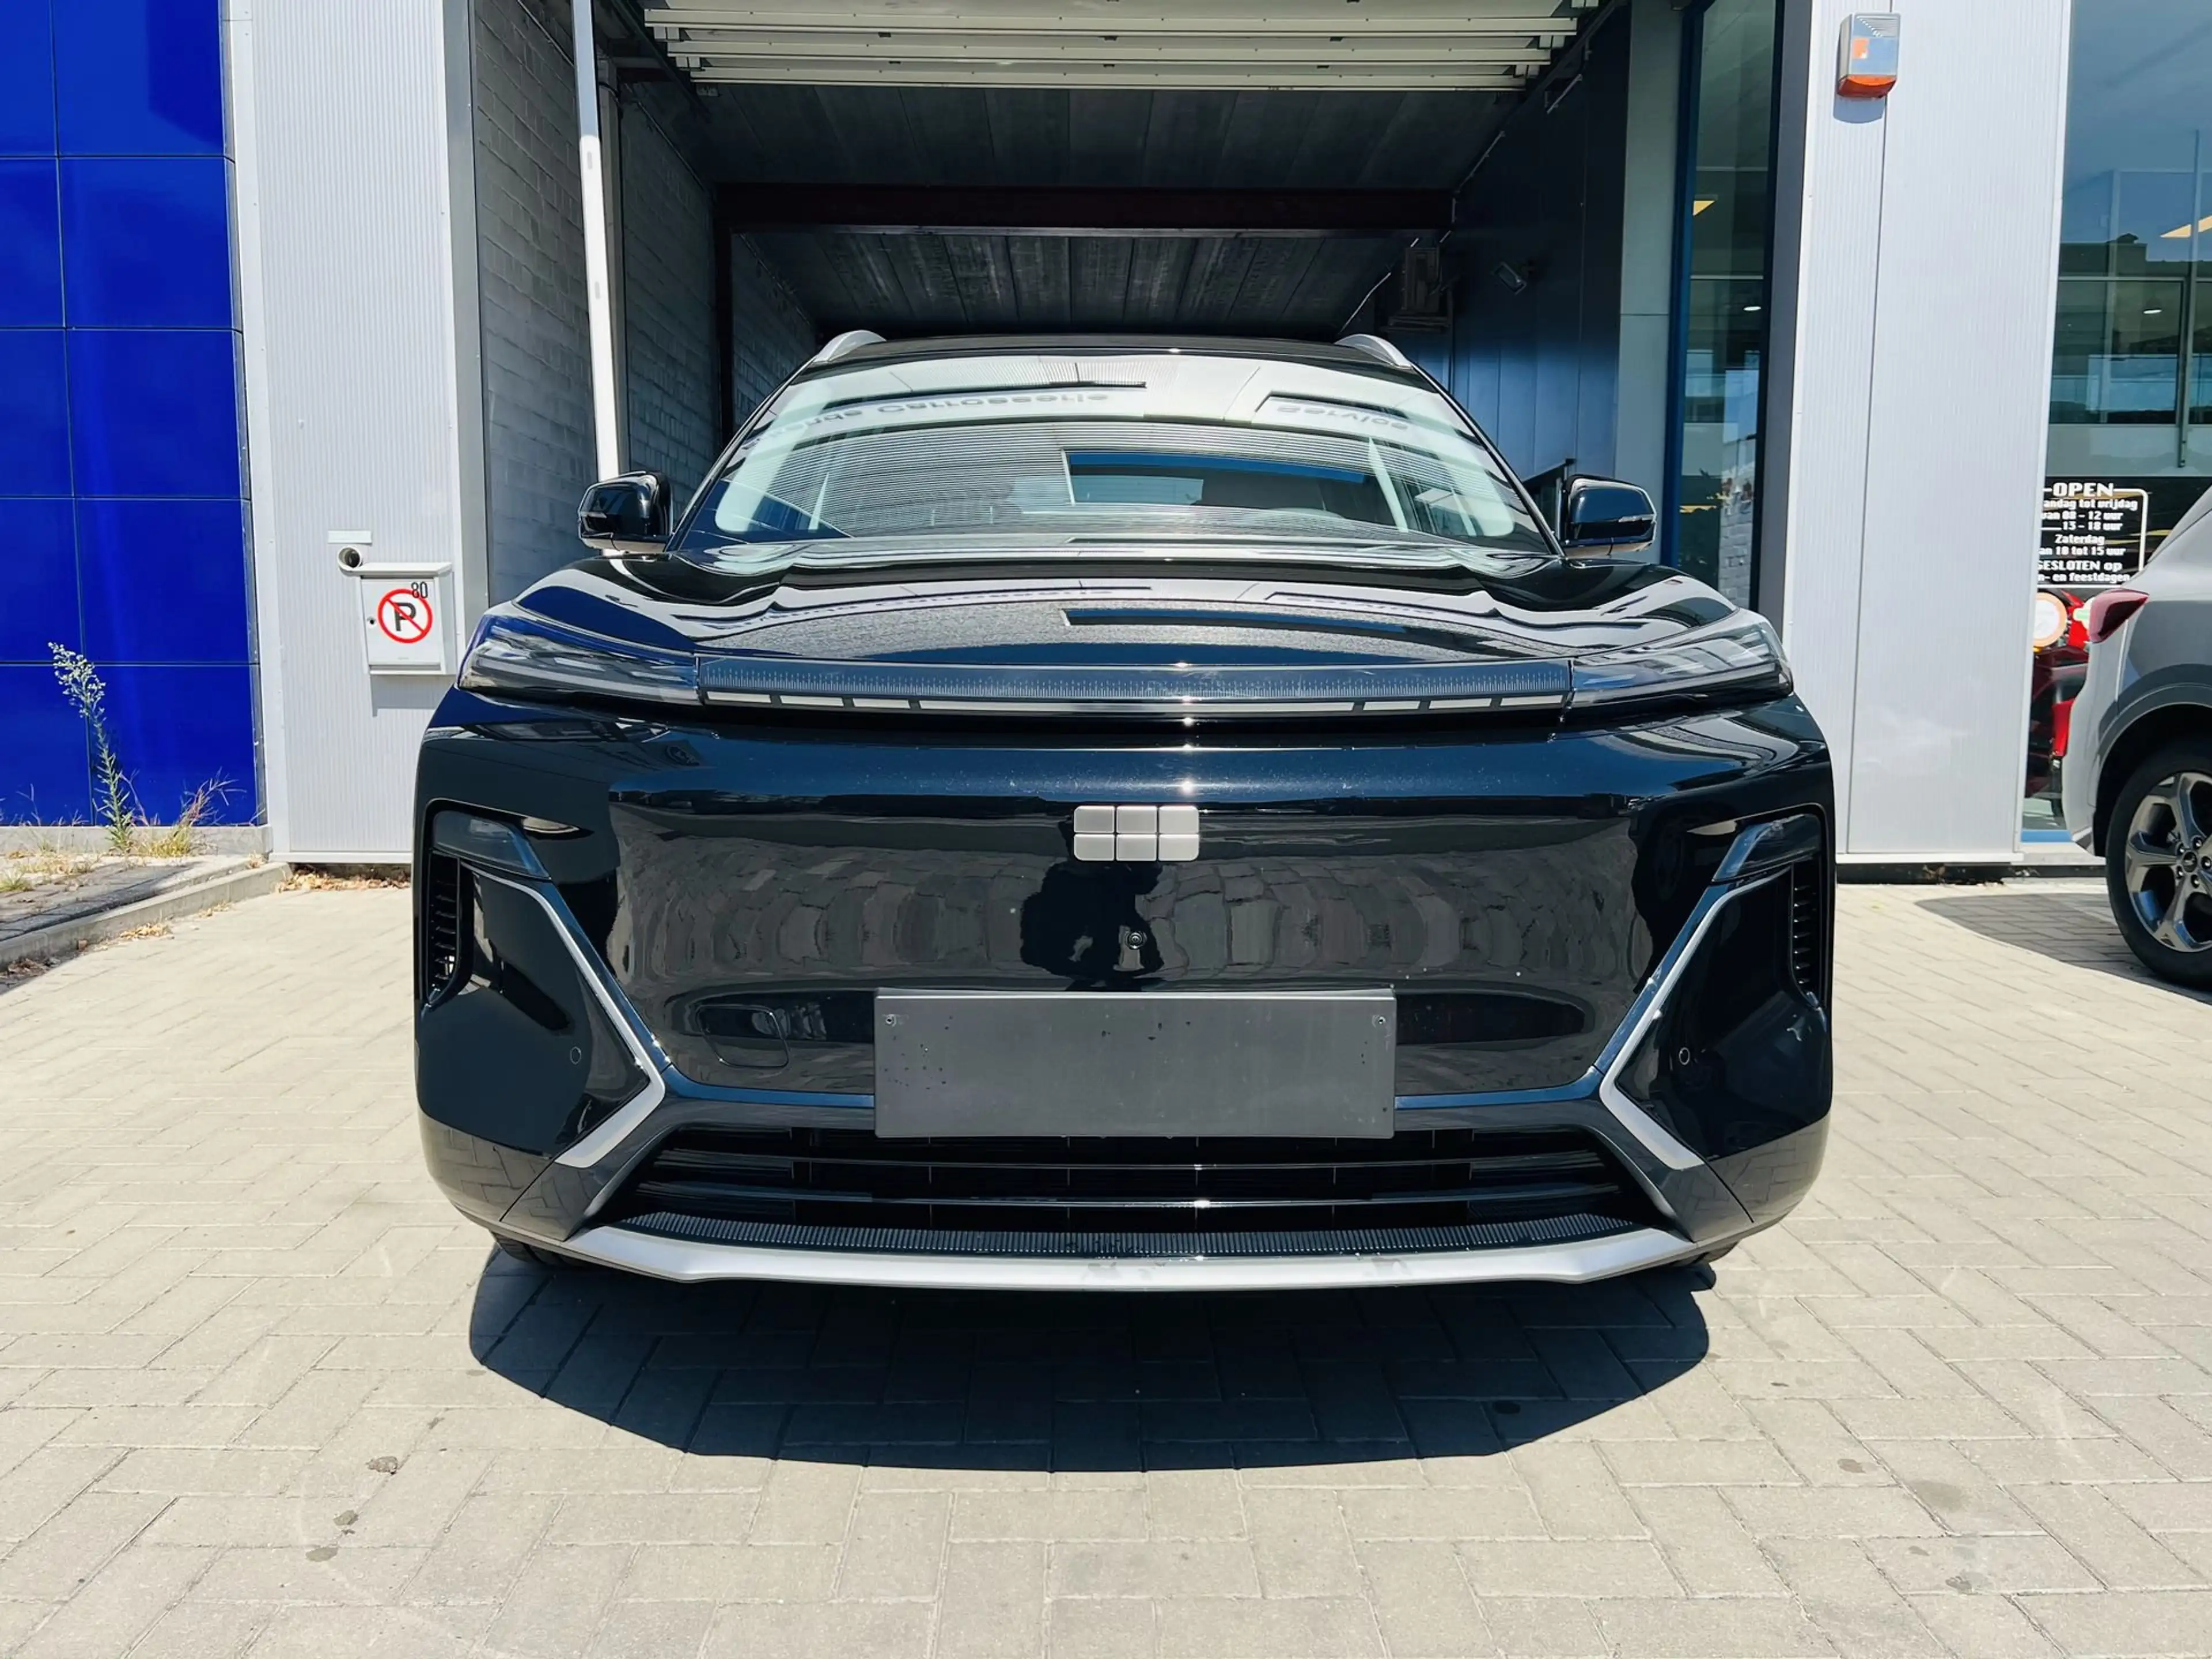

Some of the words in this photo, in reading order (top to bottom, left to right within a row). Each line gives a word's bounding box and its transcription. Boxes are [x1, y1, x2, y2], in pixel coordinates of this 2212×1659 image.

[2052, 482, 2114, 497] OPEN
[2043, 499, 2077, 510] andag
[2079, 499, 2095, 508] tot
[2097, 499, 2138, 511] vrijdag
[2088, 510, 2102, 520] 12
[2103, 512, 2124, 520] uur
[2088, 521, 2101, 531] 18
[2103, 522, 2123, 531] uur
[2055, 534, 2105, 546] Zaterdag
[2071, 546, 2088, 555] tot
[2091, 546, 2104, 555] 15
[2106, 548, 2126, 556] uur
[2104, 562, 2123, 572] op
[2052, 574, 2067, 582] en
[2069, 572, 2130, 584] feestdagen
[411, 581, 428, 599] 80
[393, 602, 416, 631] P
